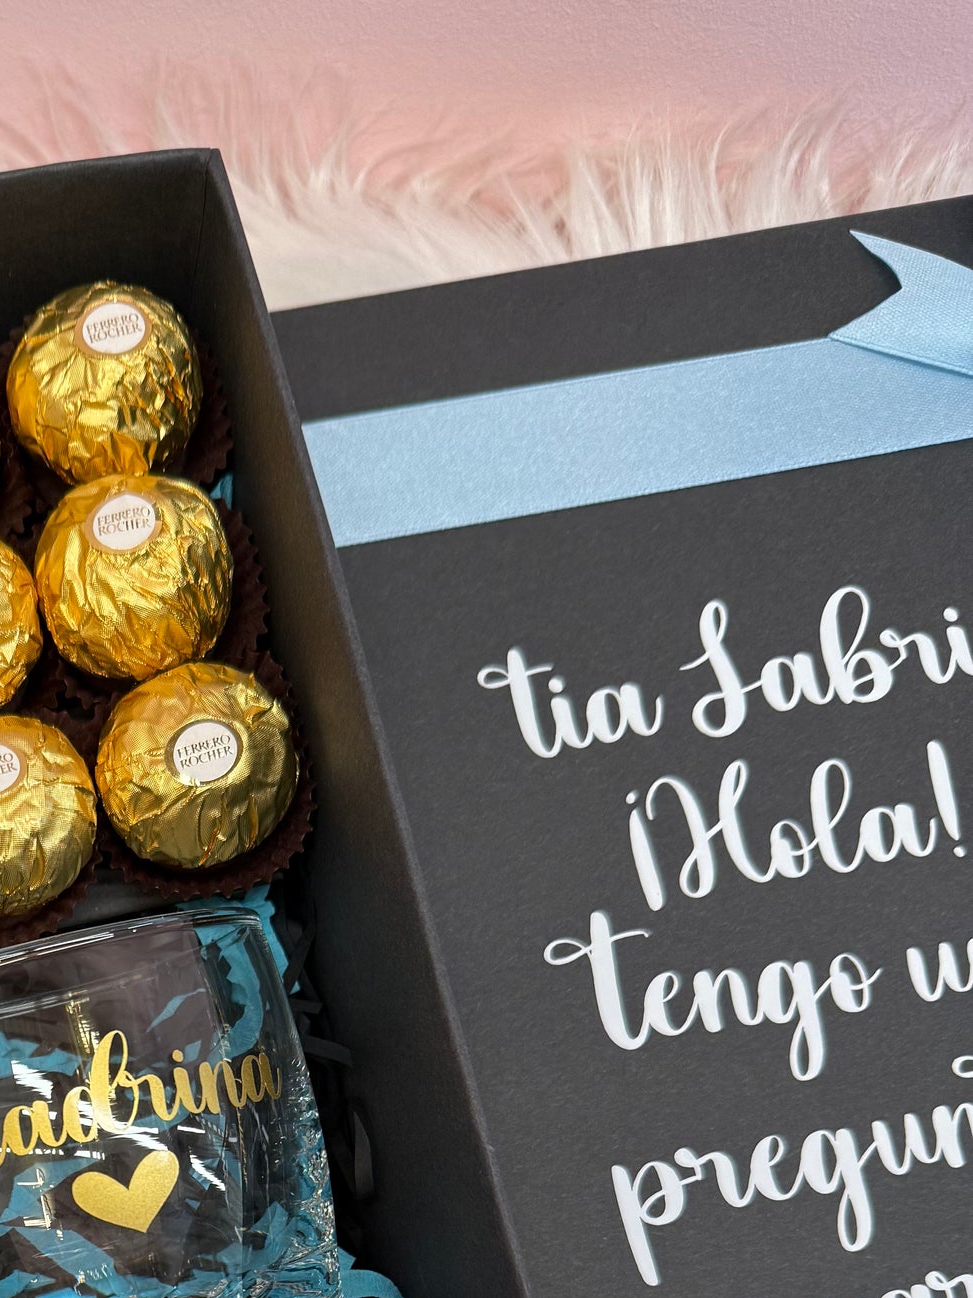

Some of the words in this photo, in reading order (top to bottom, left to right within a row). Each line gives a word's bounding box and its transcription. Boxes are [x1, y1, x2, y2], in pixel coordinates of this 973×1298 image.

[86, 312, 139, 336] FERRERO
[89, 323, 142, 344] ROCHER
[97, 505, 150, 526] FERRERO
[98, 517, 151, 537] ROCHER
[477, 649, 662, 758] tia
[177, 733, 231, 758] FERRERO
[179, 746, 233, 769] ROCHER
[626, 741, 965, 911] ¡Hola!
[544, 911, 881, 1081] tengo
[612, 1060, 973, 1286] pregun
